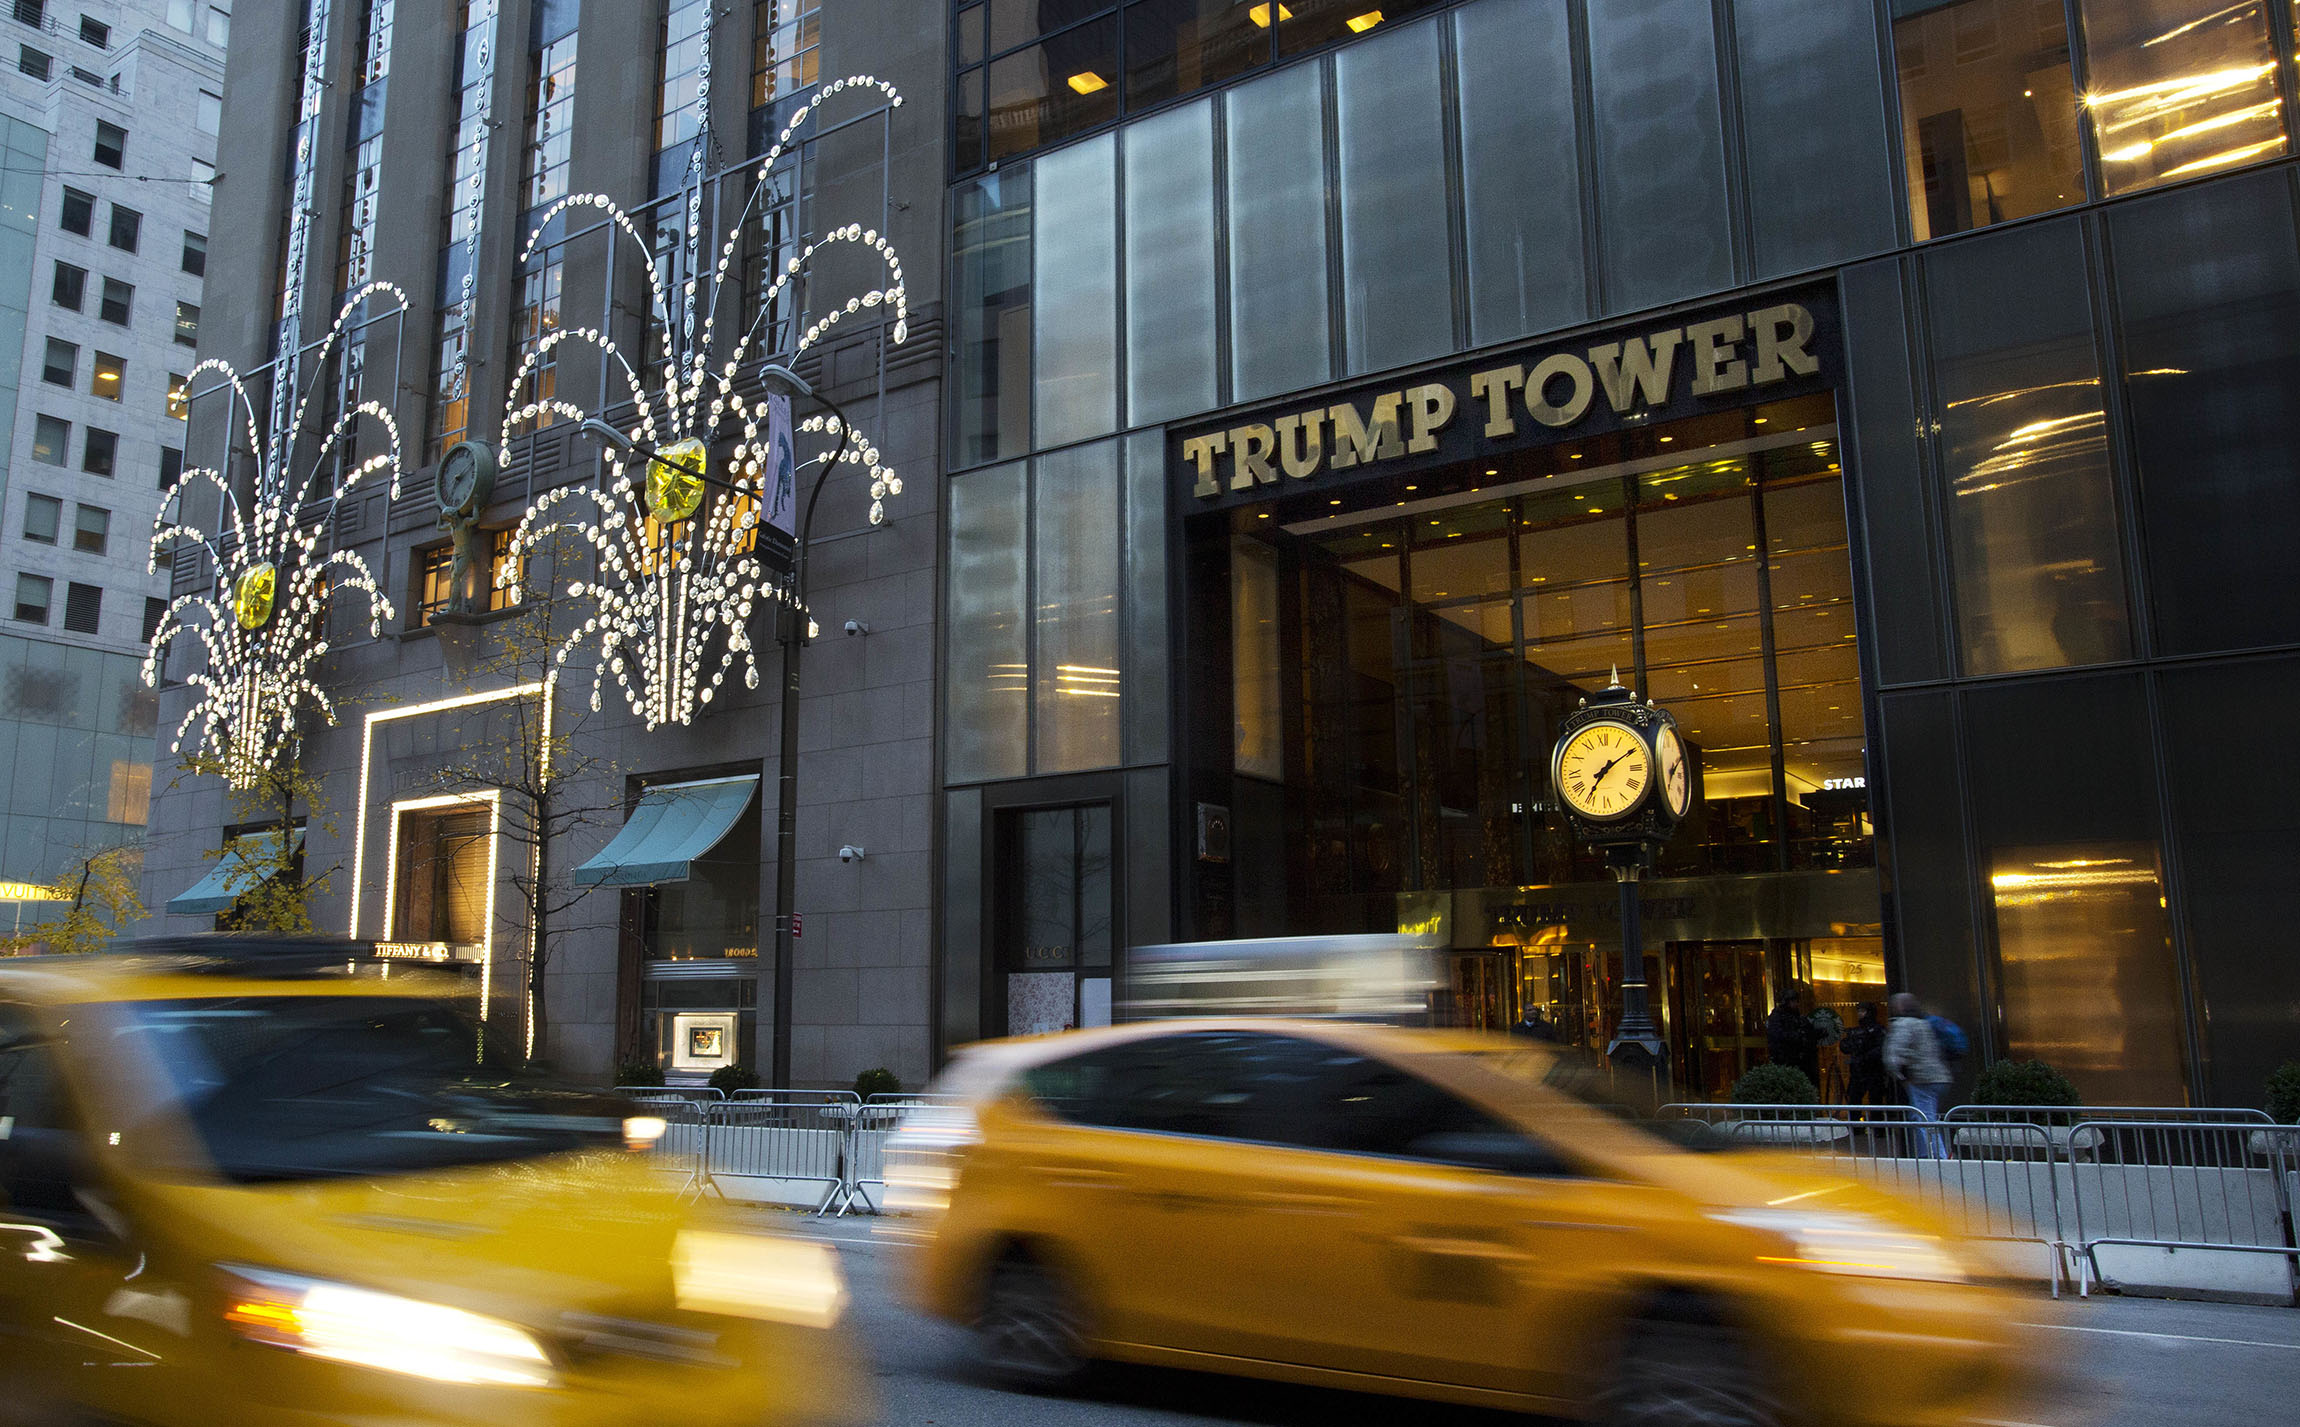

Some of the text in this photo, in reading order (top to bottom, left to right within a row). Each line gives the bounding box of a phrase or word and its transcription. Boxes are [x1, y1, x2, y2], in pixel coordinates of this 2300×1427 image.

[1184, 302, 1820, 498] TRUMP TOWER
[1570, 709, 1633, 728] TRUMP TOWER
[1823, 776, 1866, 791] STAR
[374, 944, 450, 958] TIFFANY & CO.
